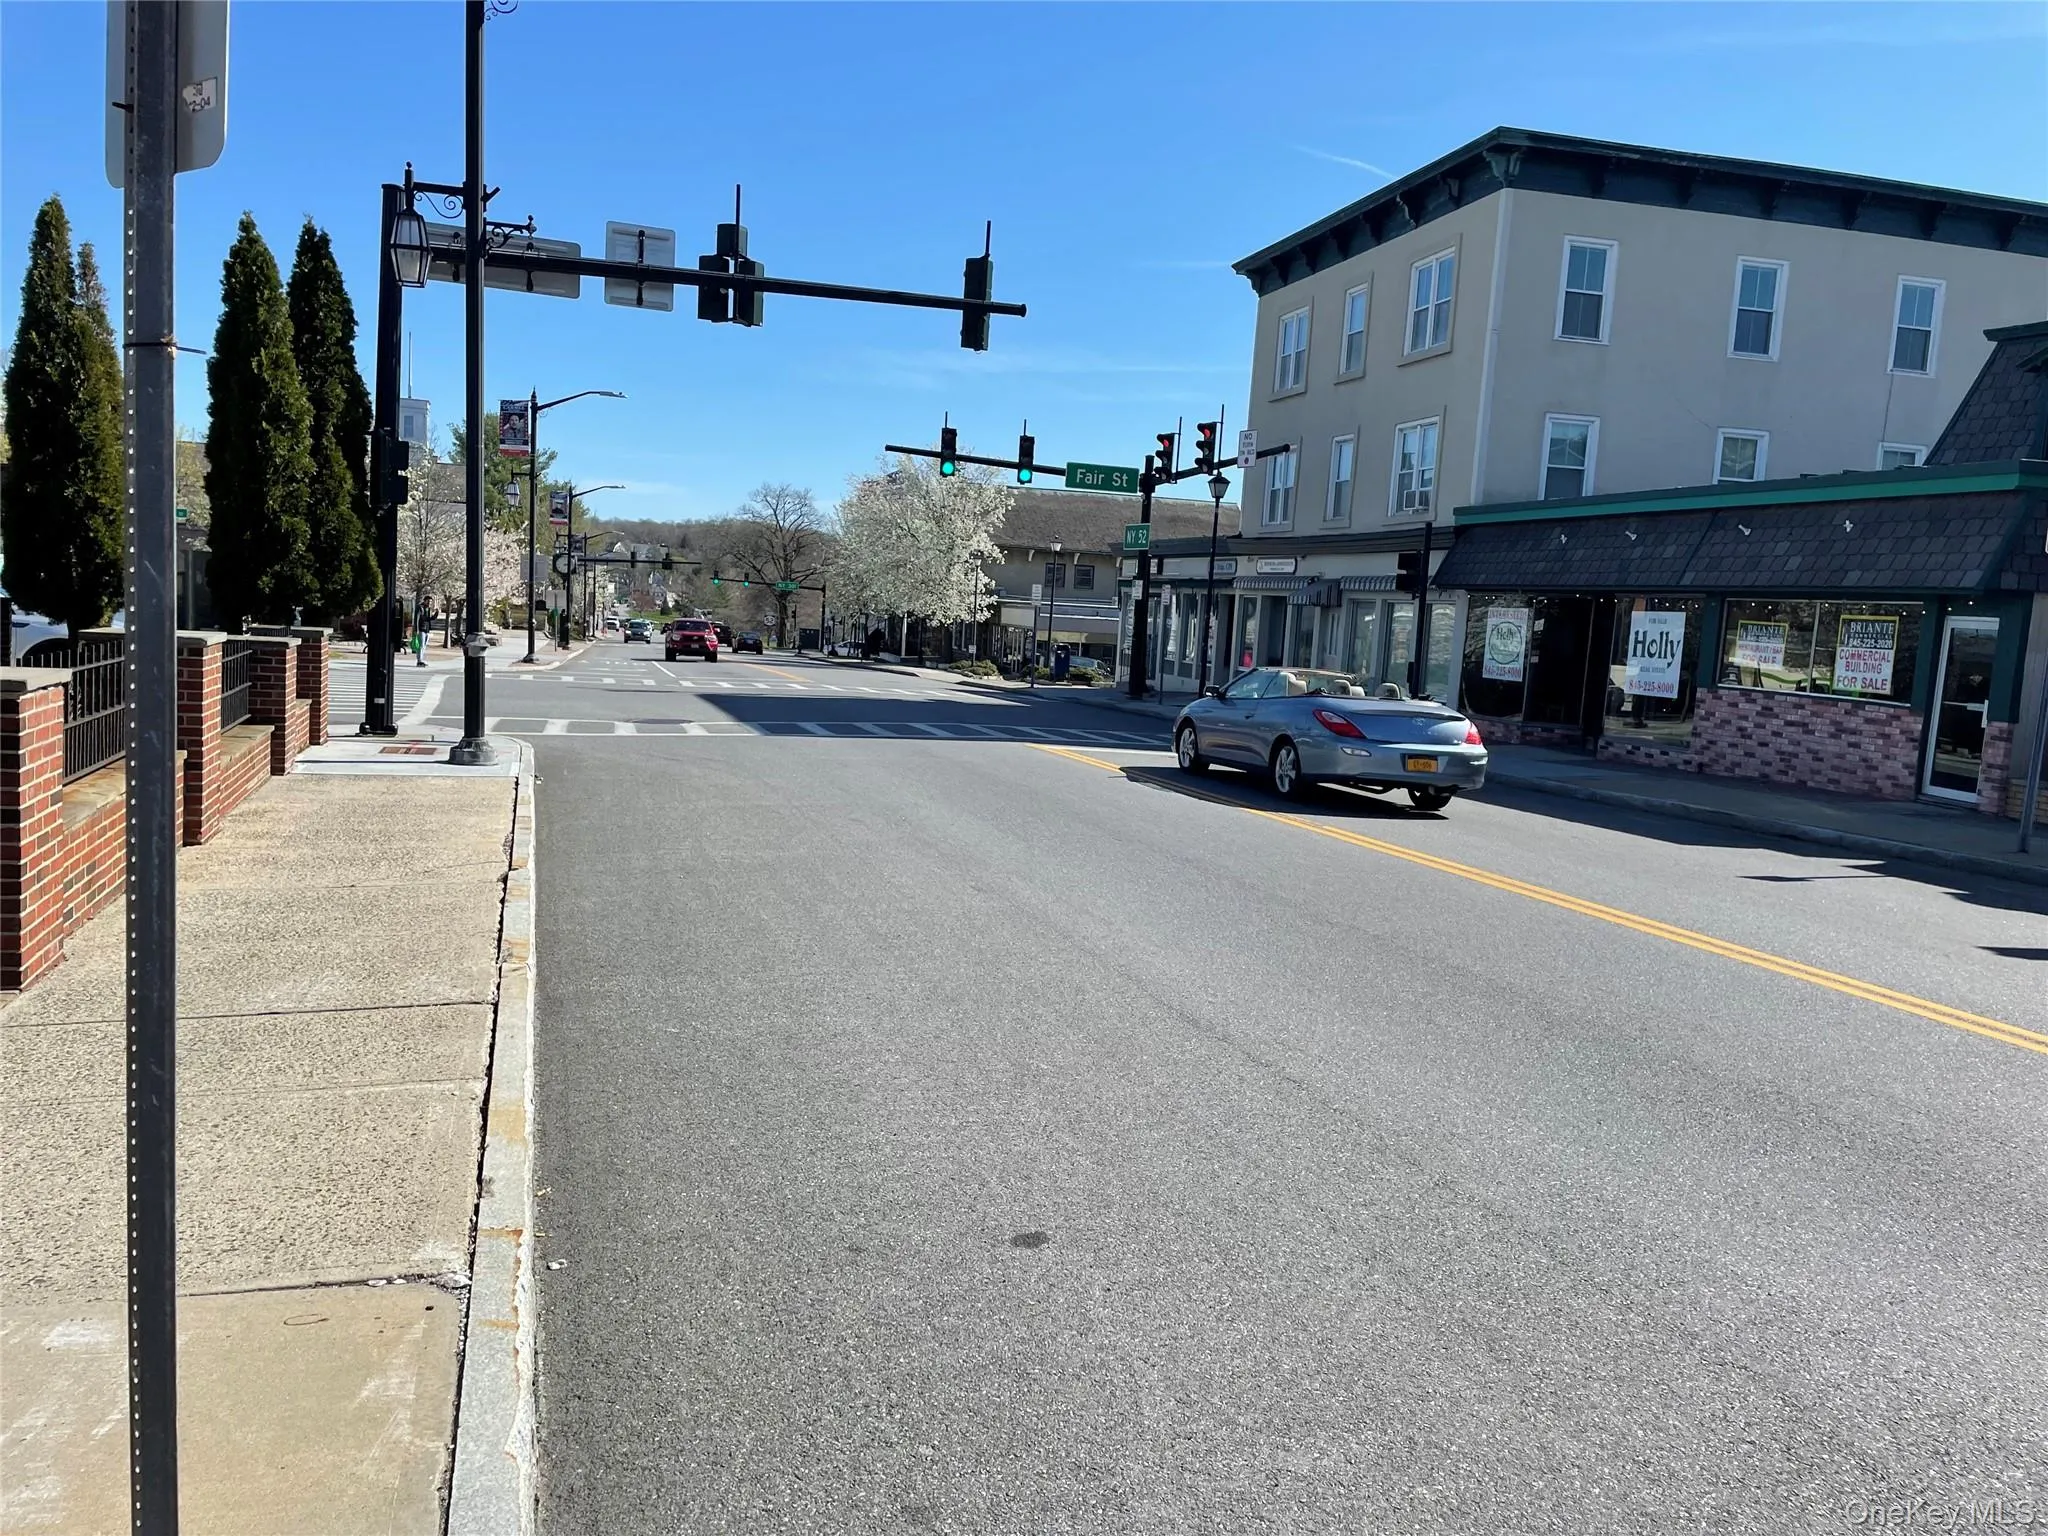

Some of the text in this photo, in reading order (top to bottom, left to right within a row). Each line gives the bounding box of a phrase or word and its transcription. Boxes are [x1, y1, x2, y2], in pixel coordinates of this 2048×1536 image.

[1243, 432, 1253, 441] NO
[1076, 468, 1129, 488] Fair St
[1126, 529, 1147, 544] NY 52
[1747, 624, 1784, 635] BRIANTE
[1850, 622, 1895, 634] BRIANTE
[1631, 629, 1682, 669] Holly
[1849, 638, 1893, 648] 845-225-2020
[1759, 655, 1777, 664] SALE
[1839, 649, 1891, 663] COMMERCIAL
[1845, 661, 1882, 674] BUILDING
[1628, 679, 1674, 694] 845-225-8000
[1836, 675, 1888, 690] FOR SALE
